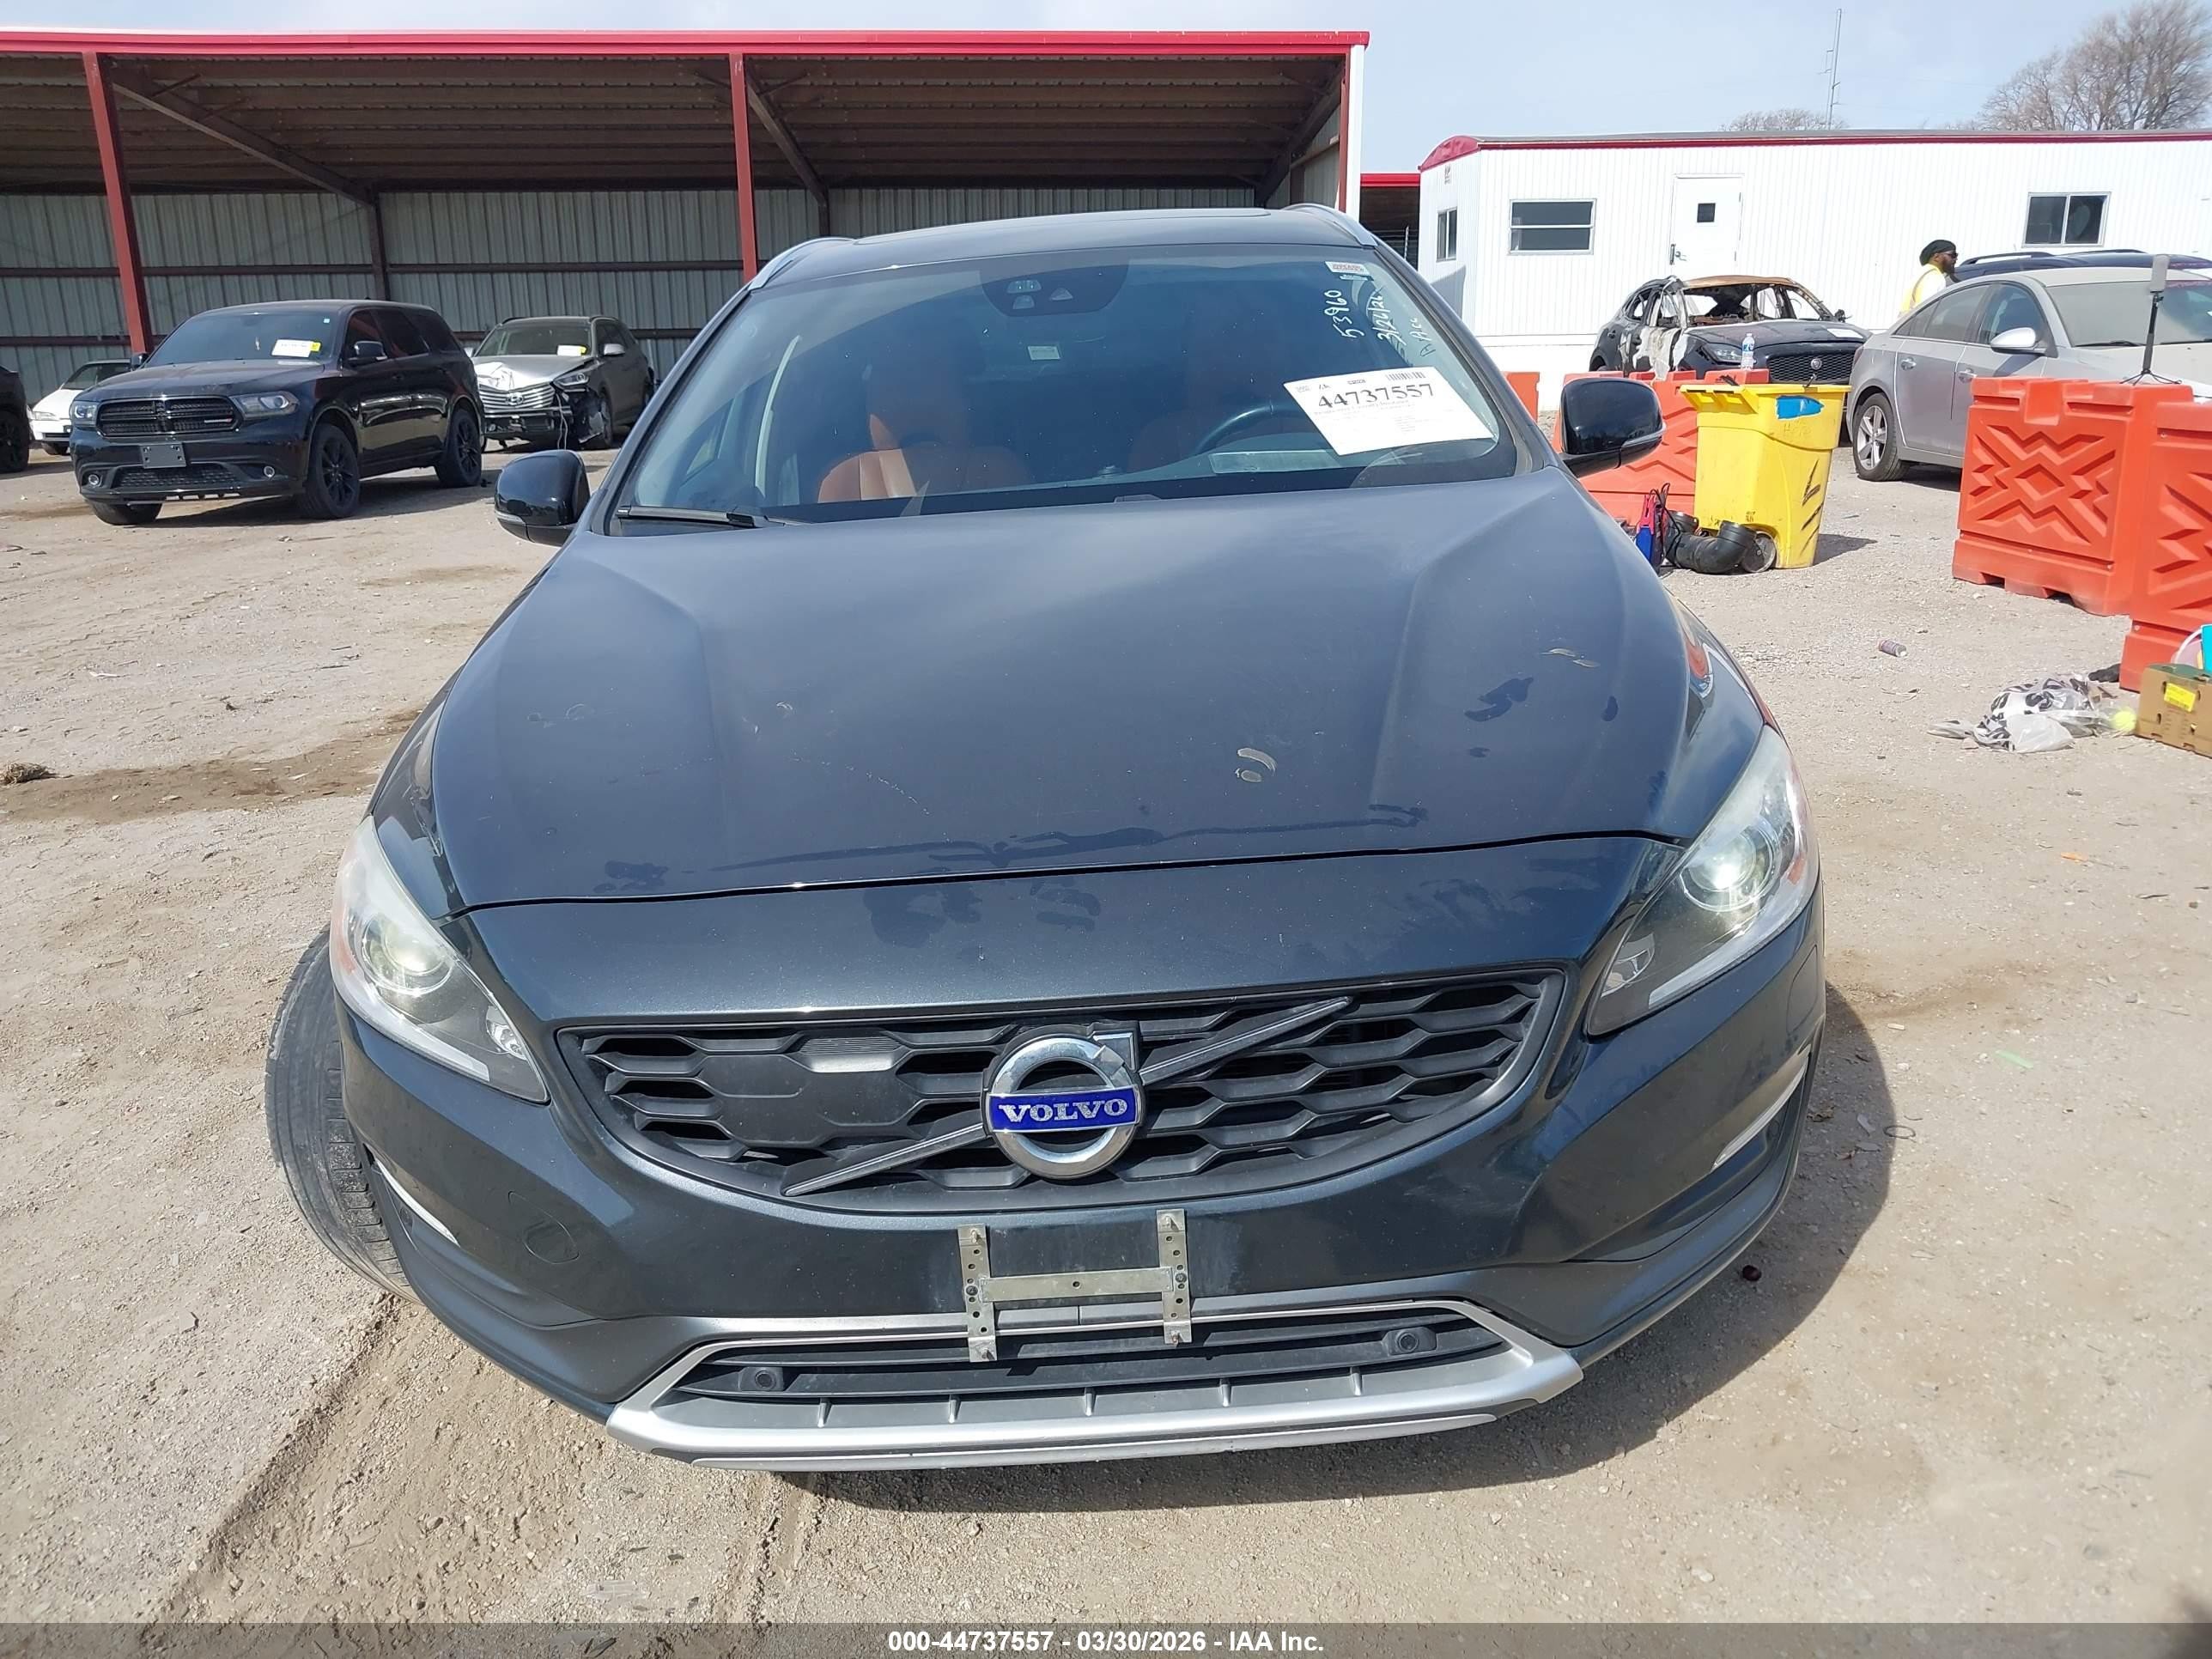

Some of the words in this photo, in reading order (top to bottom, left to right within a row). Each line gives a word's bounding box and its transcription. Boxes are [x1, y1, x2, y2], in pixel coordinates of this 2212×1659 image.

[1323, 289, 1365, 338] 53960
[1318, 383, 1435, 409] 44737557
[999, 1098, 1127, 1122] VOLVO
